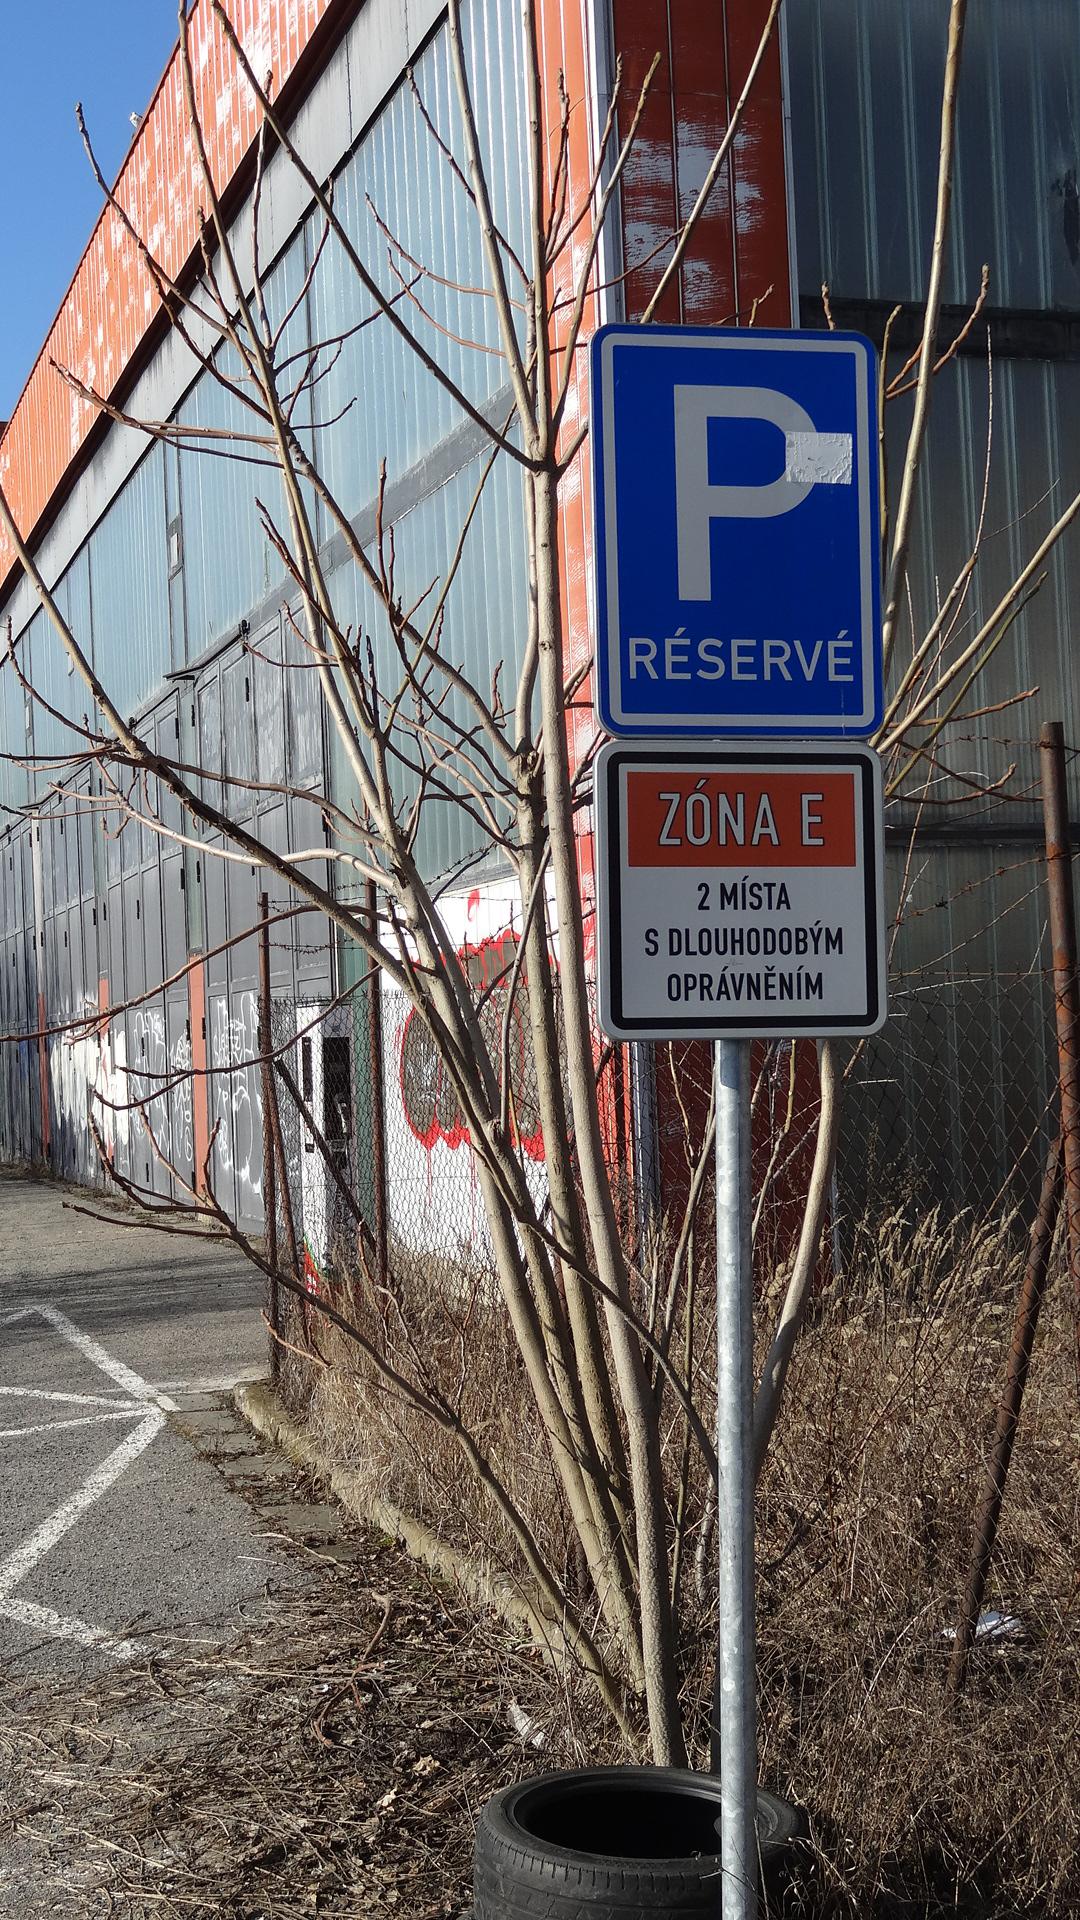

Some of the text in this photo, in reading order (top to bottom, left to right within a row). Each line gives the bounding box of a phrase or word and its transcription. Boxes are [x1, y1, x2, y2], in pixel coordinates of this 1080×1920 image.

[674, 384, 818, 601] P
[629, 627, 854, 682] RÉSERVÉ
[658, 778, 825, 847] ZÓNA E
[697, 875, 791, 911] 2 MÍSTA
[645, 920, 843, 956] S DLOUHODOBÝM
[667, 965, 824, 1001] OPRÁVNĚNÍM
